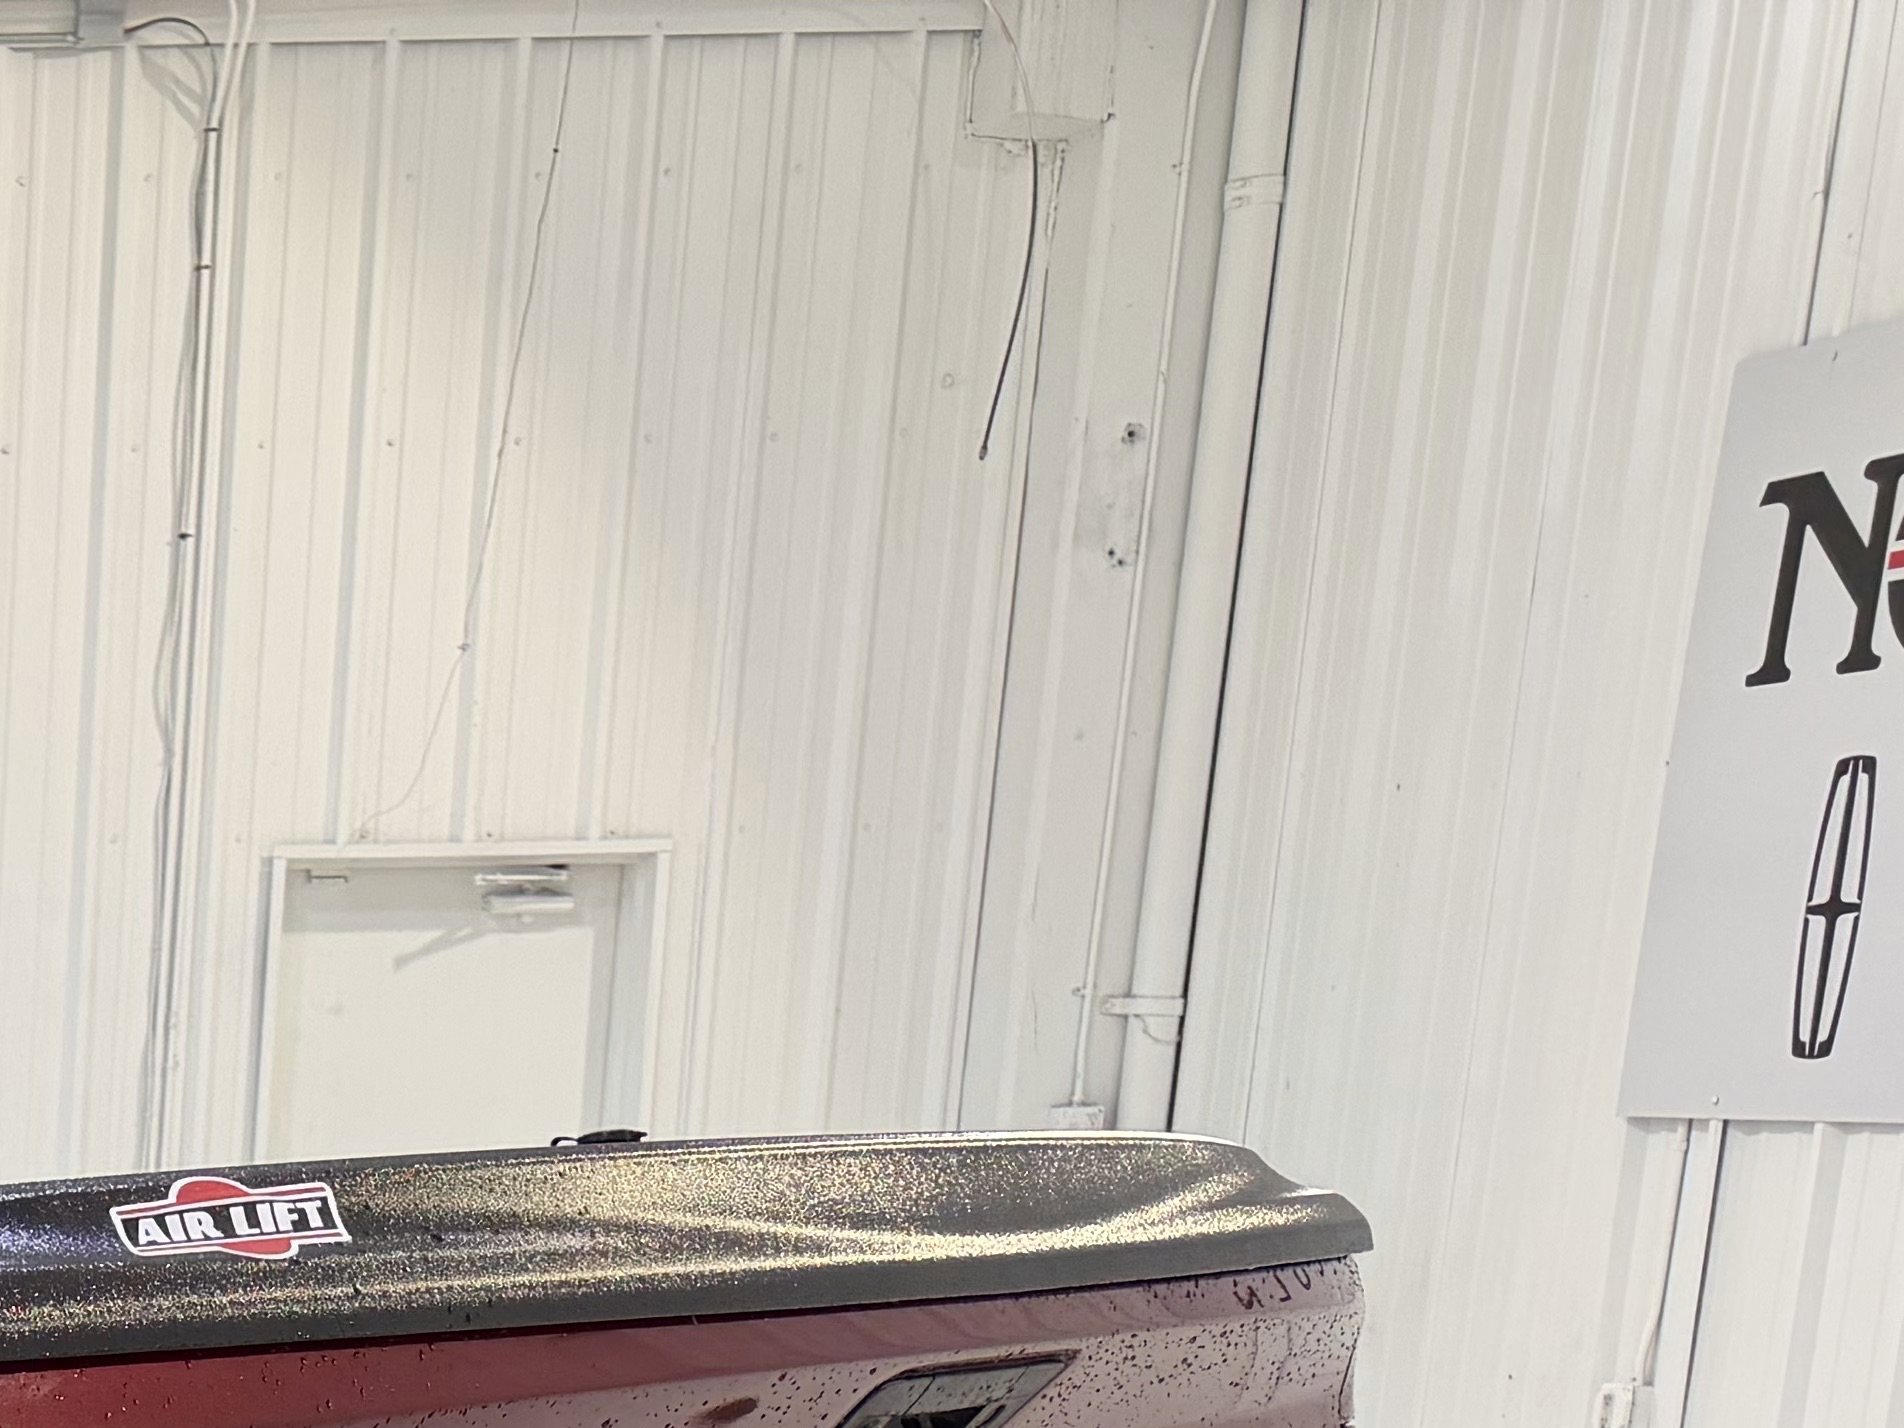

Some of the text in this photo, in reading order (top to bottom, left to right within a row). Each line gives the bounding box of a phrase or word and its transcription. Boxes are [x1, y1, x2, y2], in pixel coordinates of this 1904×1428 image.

[1745, 450, 1904, 690] N
[137, 1200, 323, 1246] AIR LIFT
